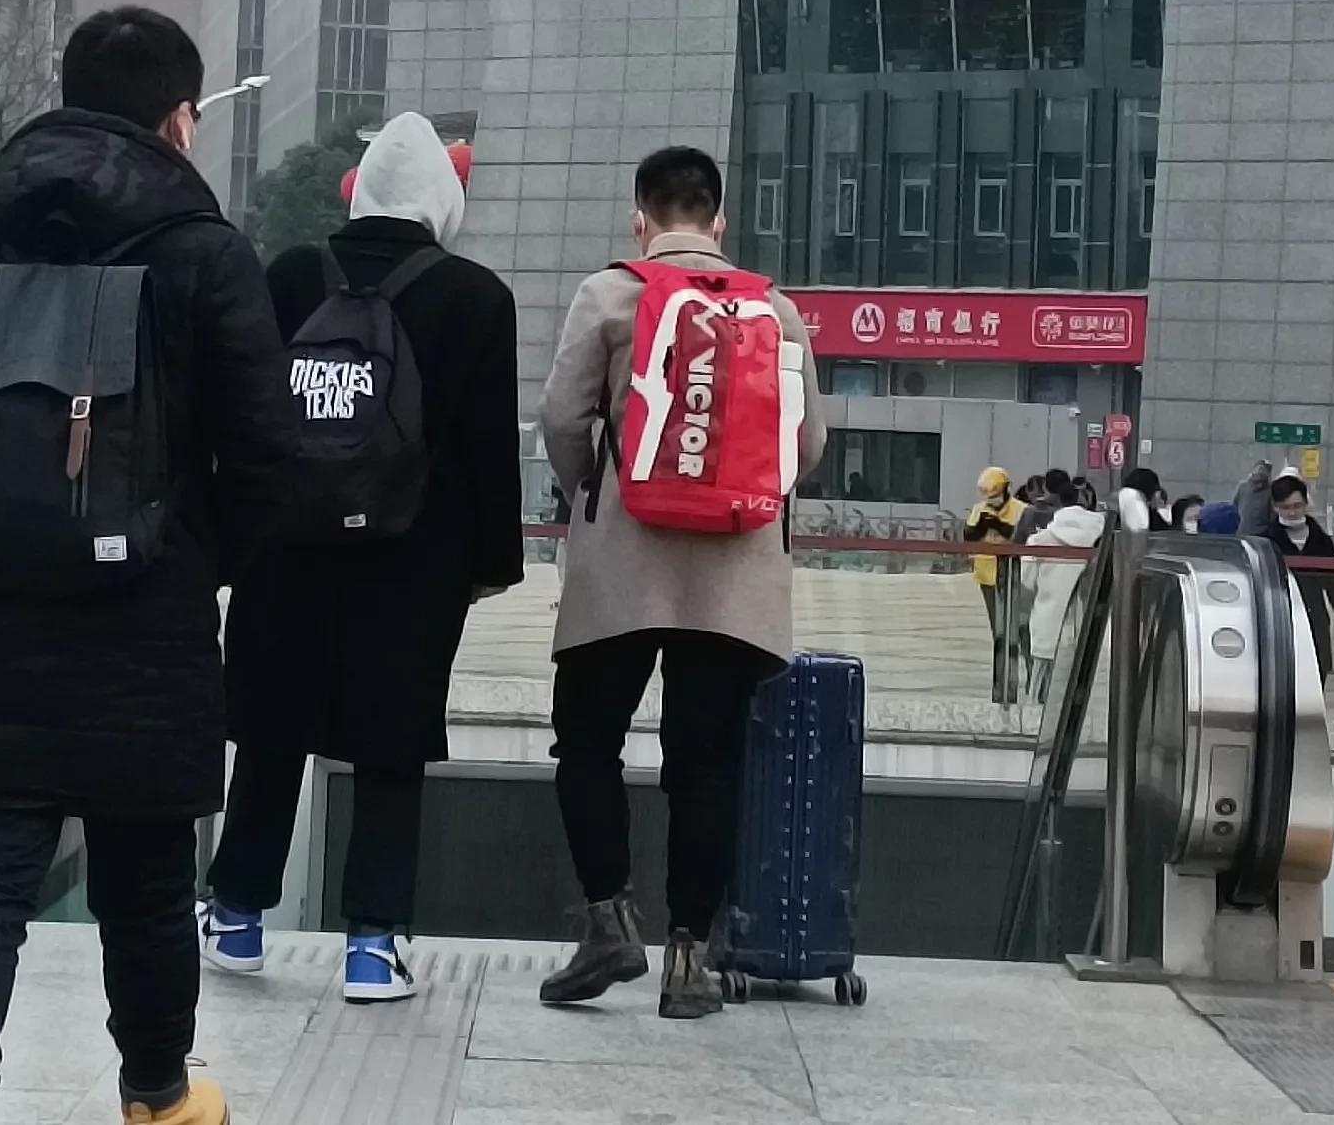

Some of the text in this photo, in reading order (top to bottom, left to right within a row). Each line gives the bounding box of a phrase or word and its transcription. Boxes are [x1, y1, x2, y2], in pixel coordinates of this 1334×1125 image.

[289, 358, 376, 397] DICKIES
[303, 387, 355, 420] TEXAS
[677, 345, 716, 479] VICTOR
